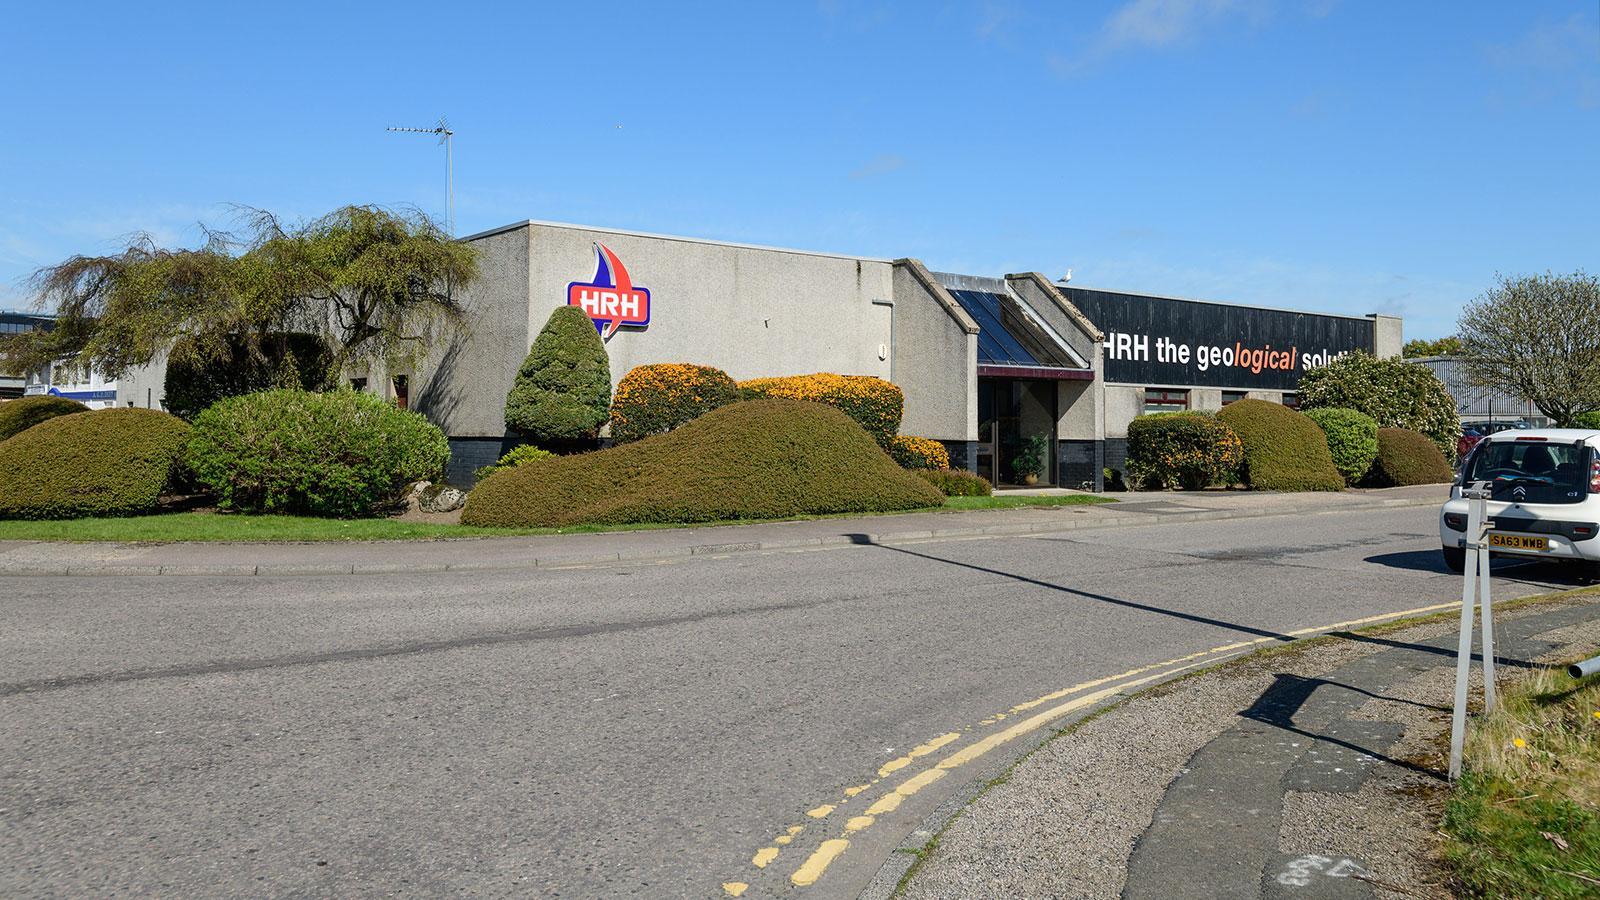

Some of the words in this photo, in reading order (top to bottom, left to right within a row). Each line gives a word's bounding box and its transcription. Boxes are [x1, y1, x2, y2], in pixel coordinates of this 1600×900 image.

[580, 290, 639, 317] HRH
[1103, 332, 1149, 361] HRH
[1155, 337, 1190, 364] the
[1197, 342, 1297, 374] geological
[1493, 535, 1520, 547] SA63
